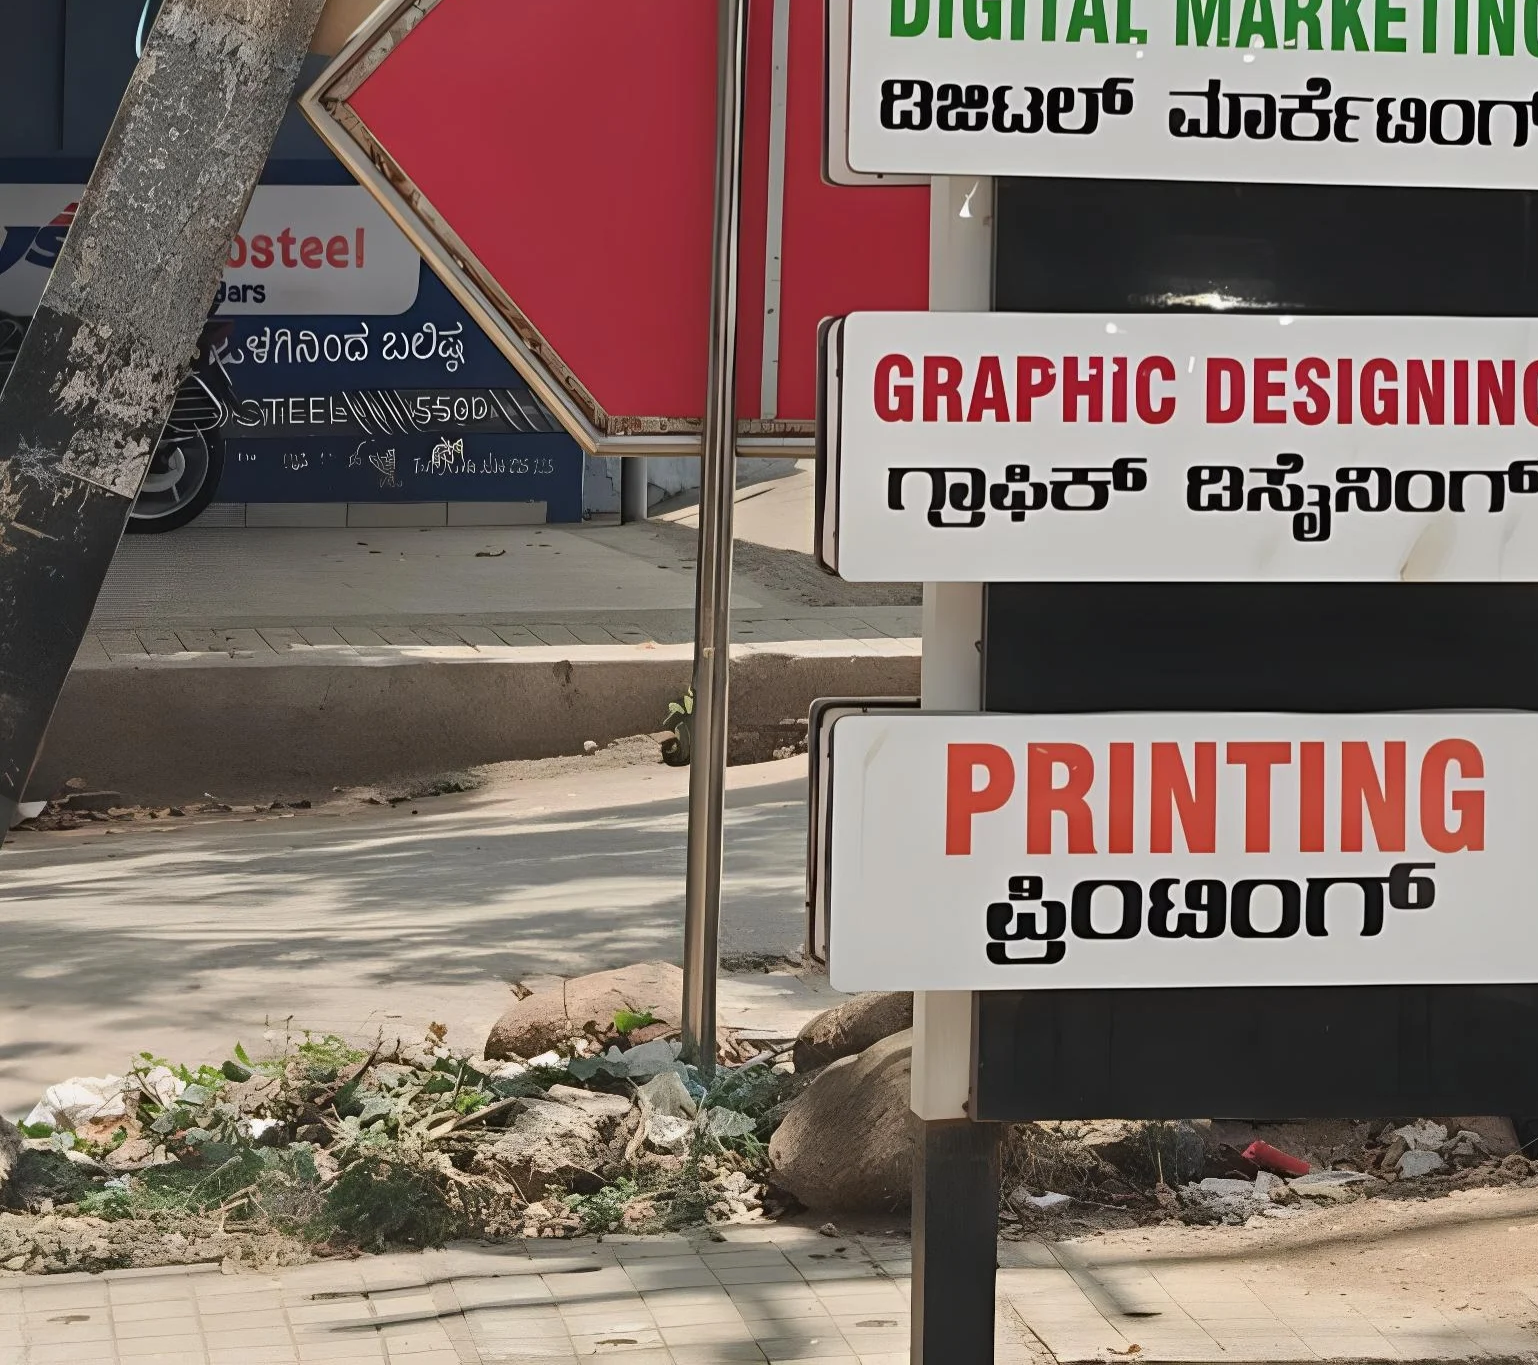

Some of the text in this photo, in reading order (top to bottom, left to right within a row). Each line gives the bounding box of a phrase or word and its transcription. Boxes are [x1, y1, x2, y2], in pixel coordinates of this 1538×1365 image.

[879, 77, 1135, 136] ಡಿಜಿಟಲ್
[873, 352, 1177, 425] GRAPHIC
[887, 457, 1148, 529] ಗ್ರಾಫಿಕ್
[945, 737, 1486, 857] PRINTING
[985, 861, 1437, 966] ಪ್ರಿಂಟಿಂಗ್
